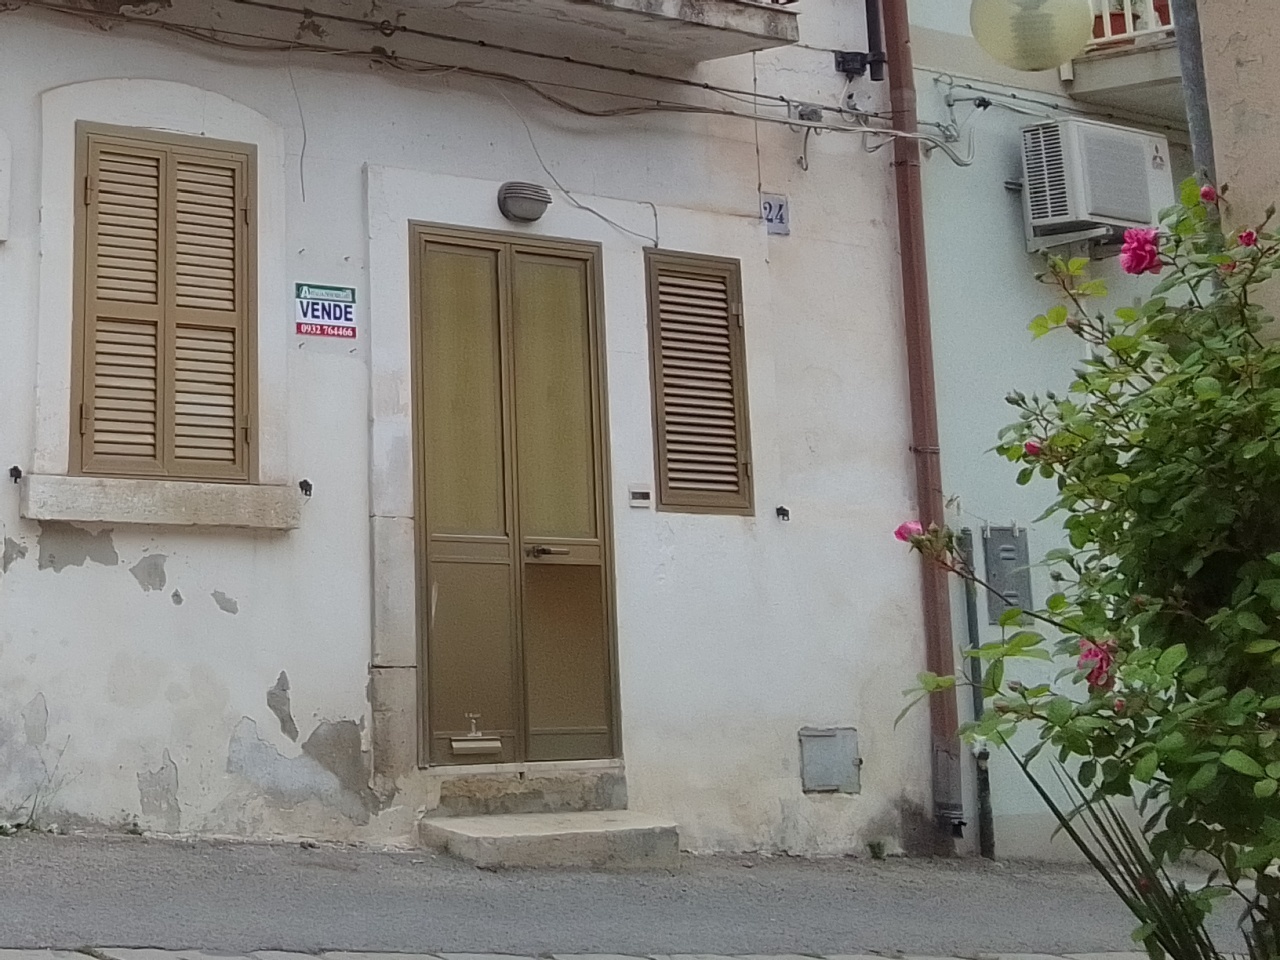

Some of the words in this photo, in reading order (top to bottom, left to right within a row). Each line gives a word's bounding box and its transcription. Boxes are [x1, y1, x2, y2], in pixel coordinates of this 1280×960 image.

[763, 201, 785, 224] 24
[300, 300, 353, 322] VENDE
[301, 324, 321, 334] 0932
